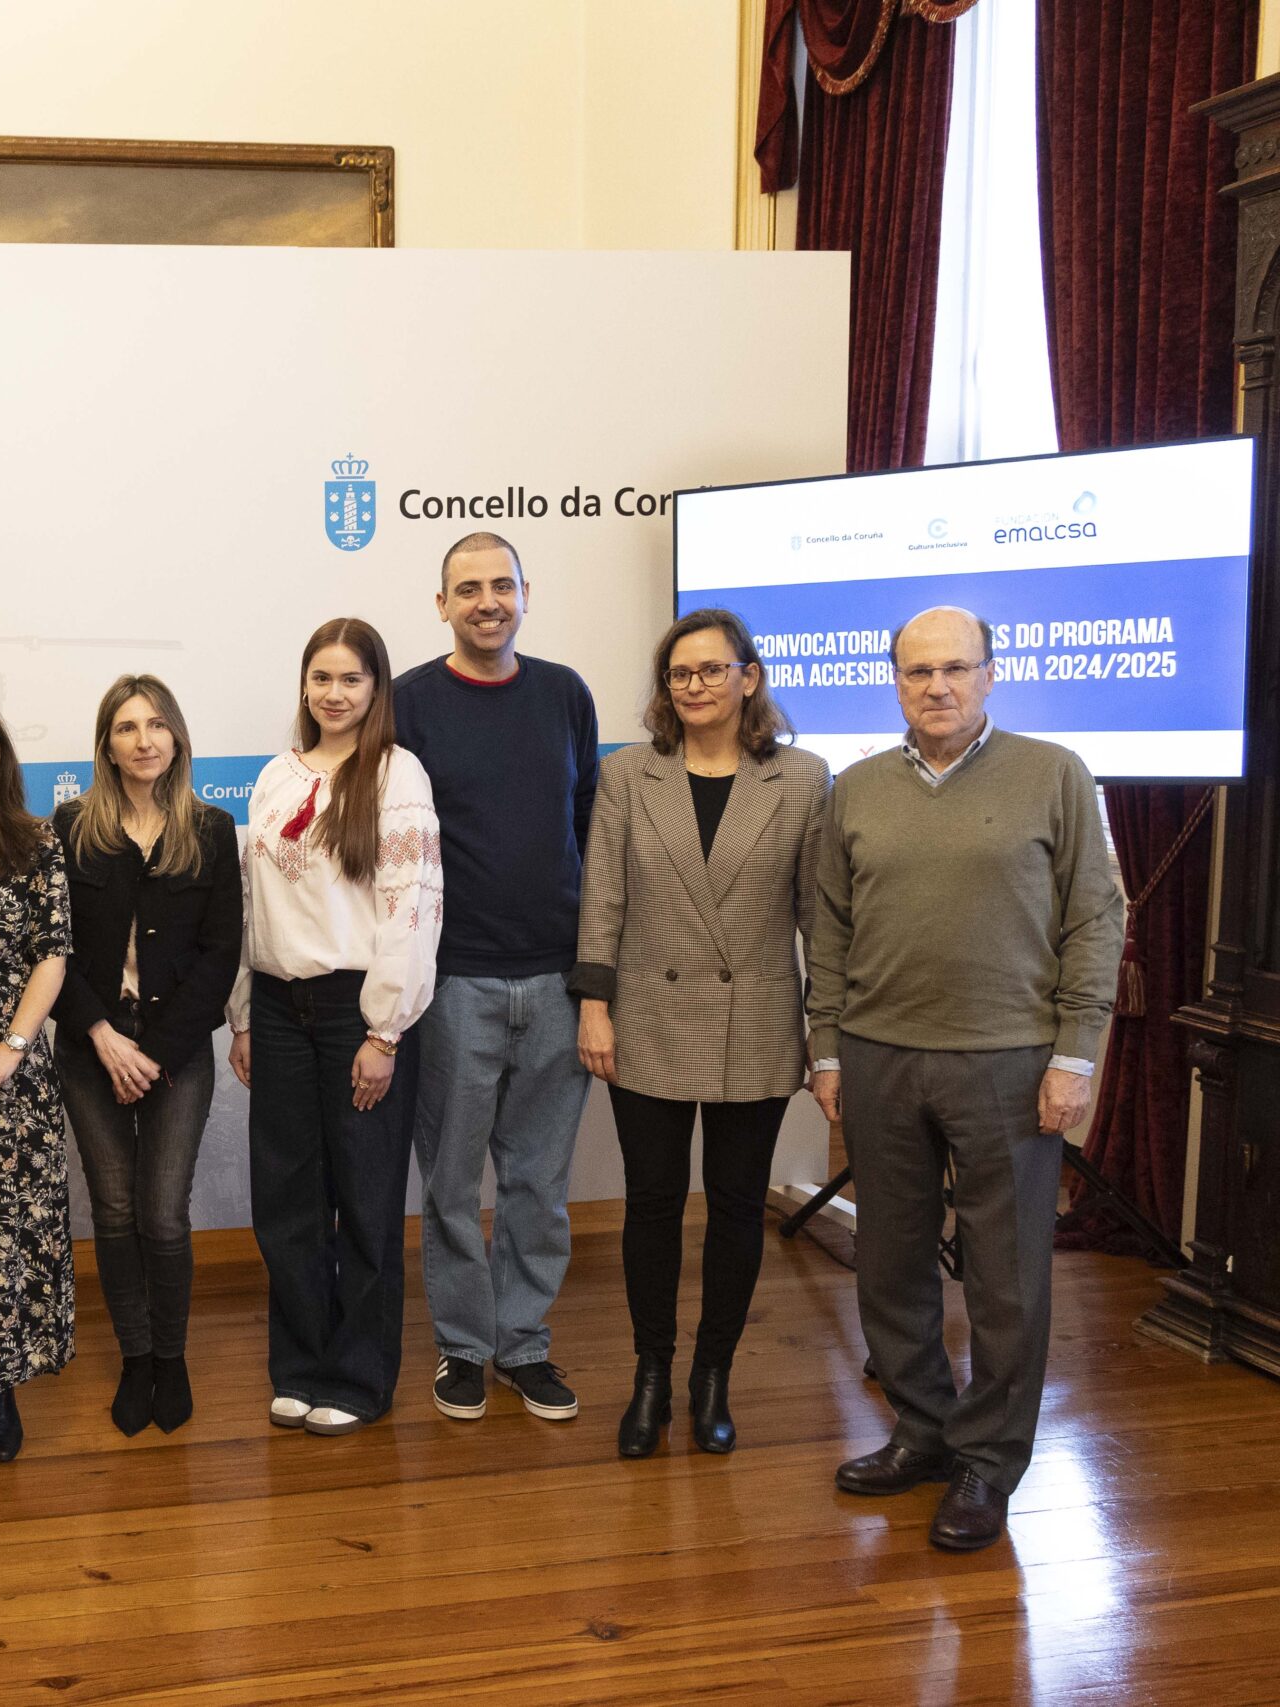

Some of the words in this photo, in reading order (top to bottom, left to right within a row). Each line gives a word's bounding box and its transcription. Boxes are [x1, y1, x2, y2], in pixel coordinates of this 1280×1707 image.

[399, 486, 548, 519] Concello
[560, 486, 601, 517] da
[614, 487, 672, 516] Cor
[806, 535, 840, 544] Concello
[908, 543, 935, 551] Cultura
[935, 540, 968, 549] Inclusiva
[753, 629, 891, 657] CONVOCATORIA
[1015, 622, 1044, 649] DO
[1049, 616, 1174, 648] PROGRAMA
[808, 661, 896, 687] ACCESIBL
[1044, 651, 1177, 681] 2024/2025
[202, 781, 255, 799] Coruñ
